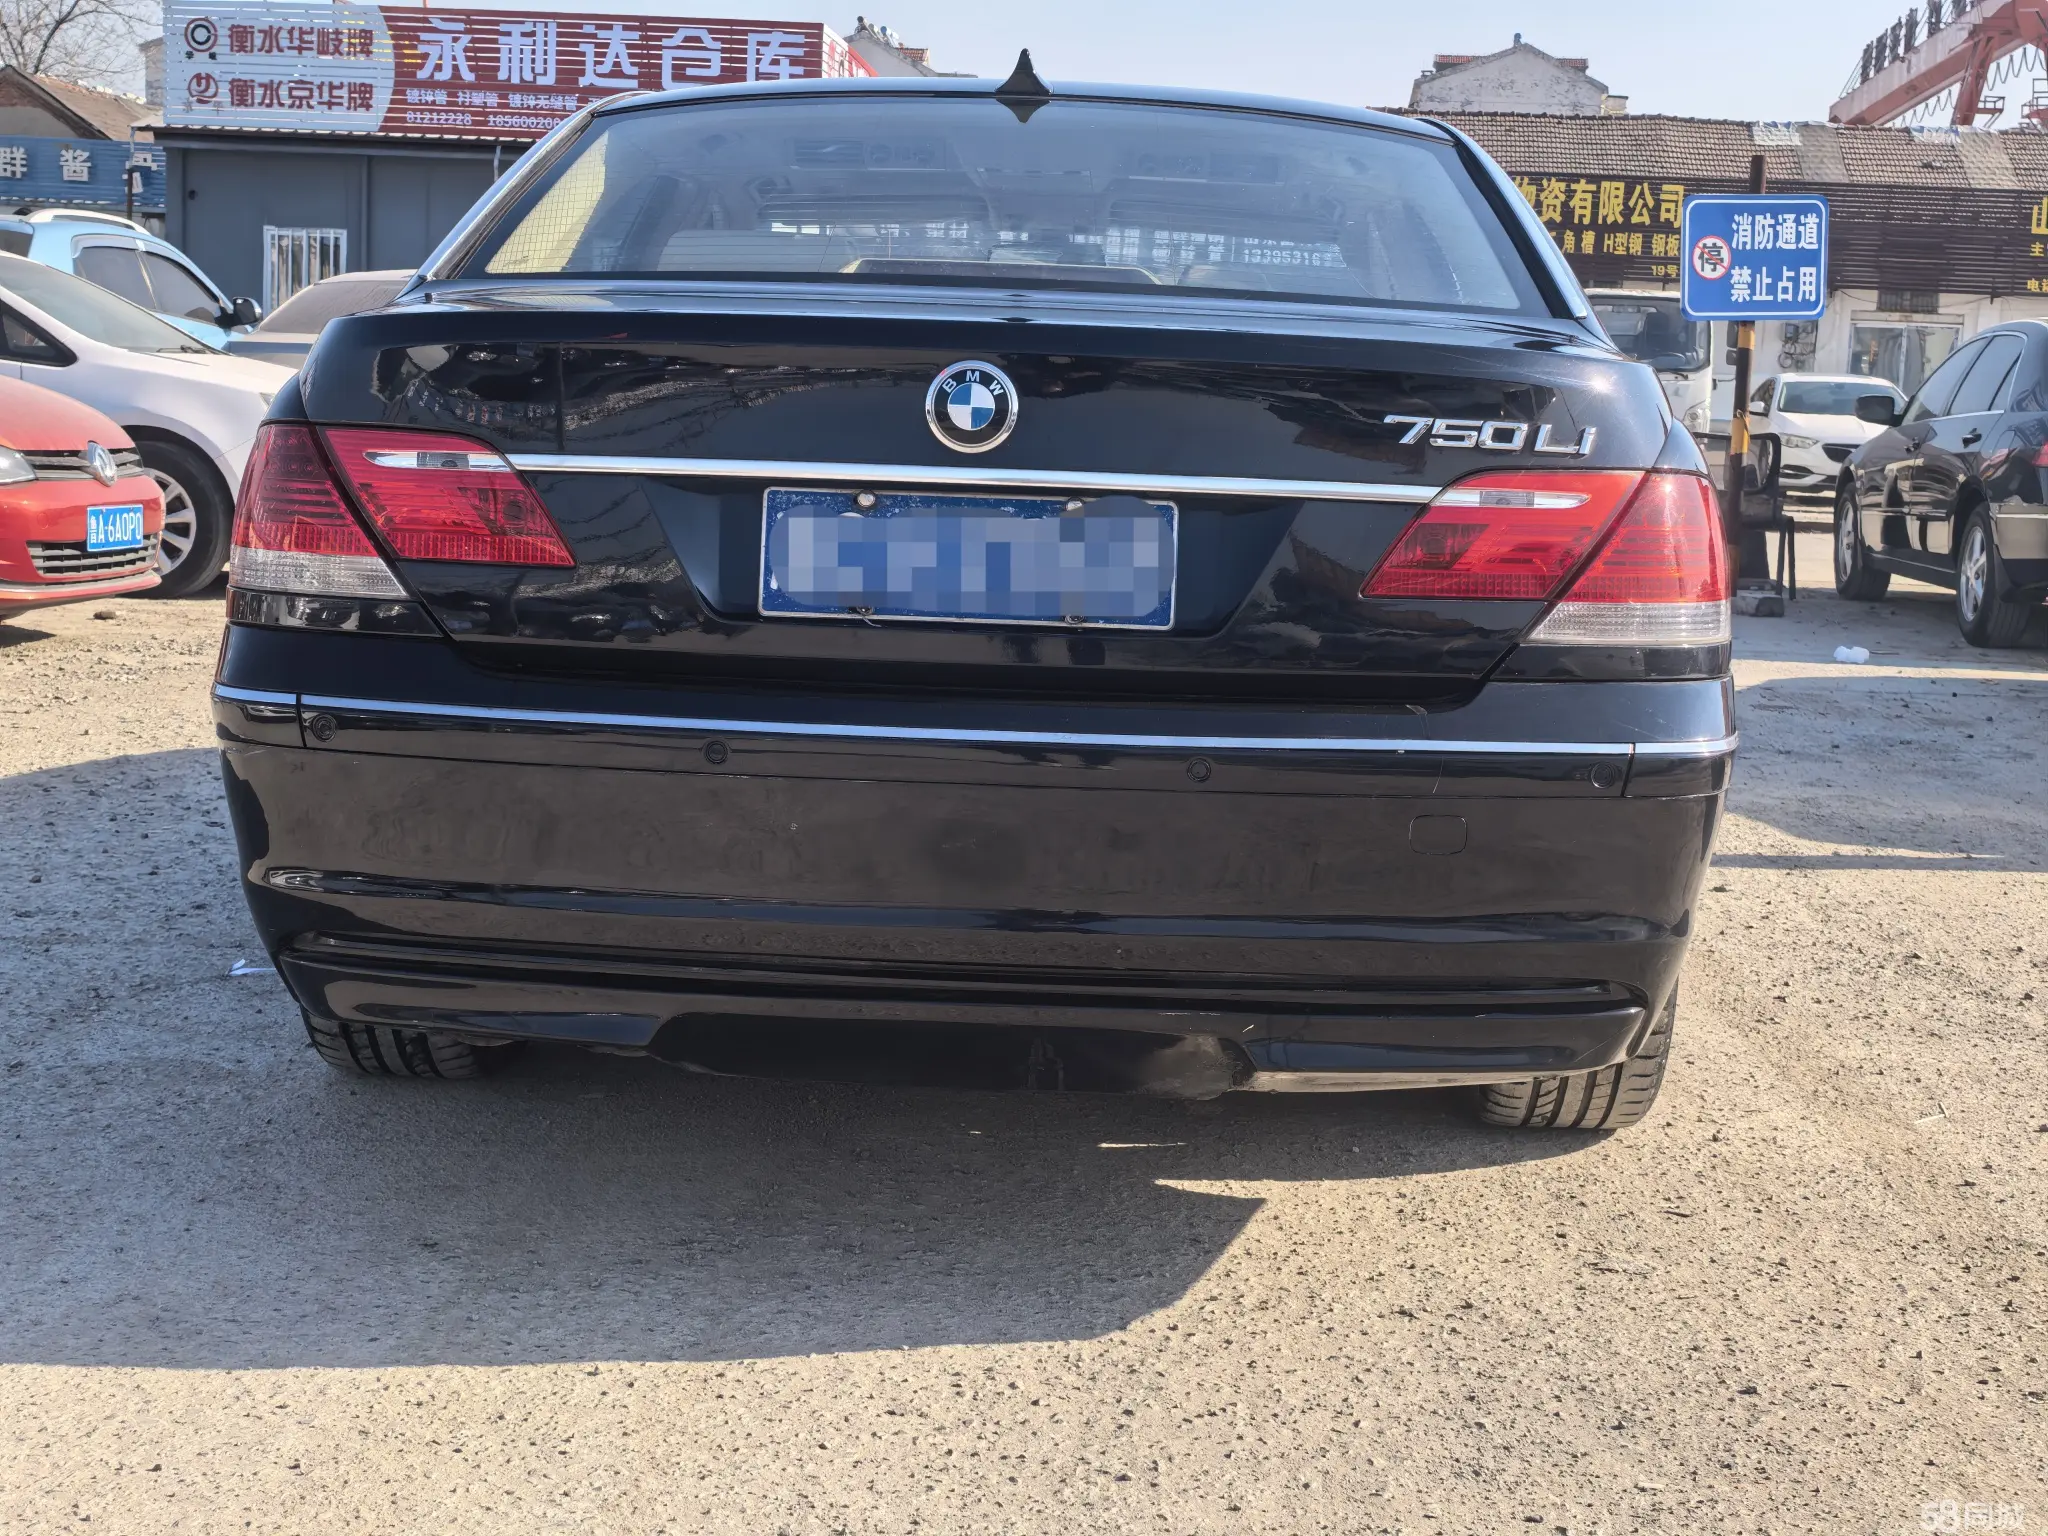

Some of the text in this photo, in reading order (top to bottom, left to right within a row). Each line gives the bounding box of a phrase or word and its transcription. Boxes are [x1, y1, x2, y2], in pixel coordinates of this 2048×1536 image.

[228, 24, 373, 57] 衡水华岐牌
[416, 18, 805, 92] 永利达仓库
[228, 77, 373, 111] 衡水京华牌
[406, 111, 472, 125] 81212228
[1731, 213, 1819, 250] 消防通道
[1698, 243, 1724, 272] 停
[1730, 266, 1817, 302] 禁止占用
[941, 369, 1005, 397] BMW
[1383, 414, 1598, 457] 750Li
